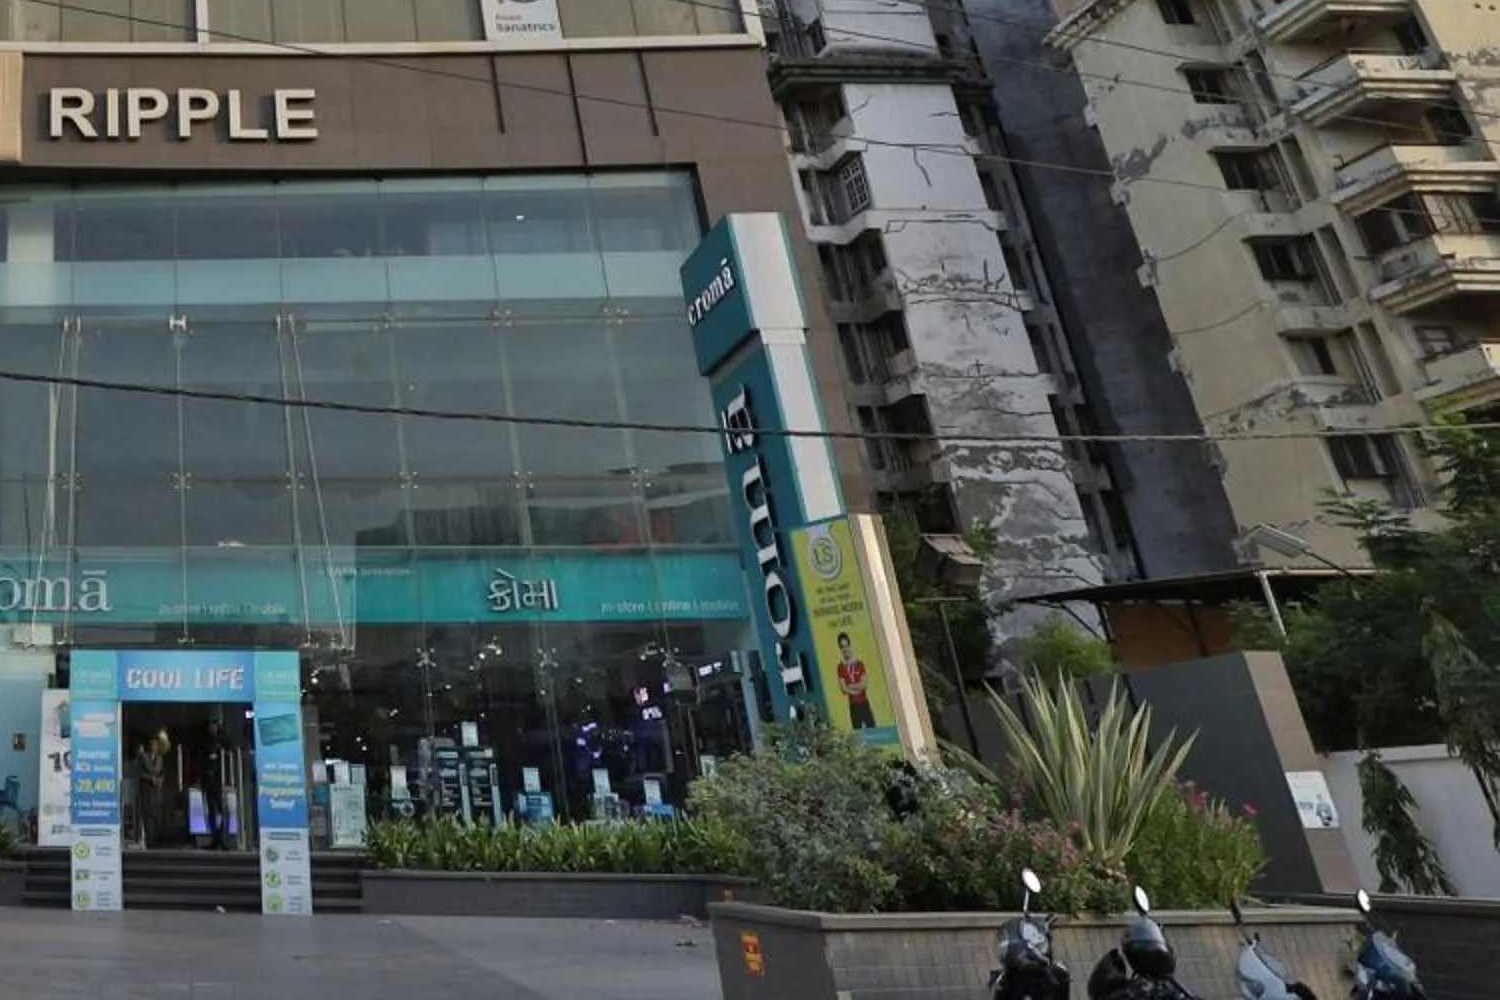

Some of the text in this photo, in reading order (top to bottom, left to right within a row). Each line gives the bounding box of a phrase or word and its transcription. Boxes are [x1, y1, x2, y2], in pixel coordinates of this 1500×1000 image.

[50, 87, 318, 138] RIPPLE
[127, 667, 181, 689] COOL
[193, 665, 244, 689] LIFE
